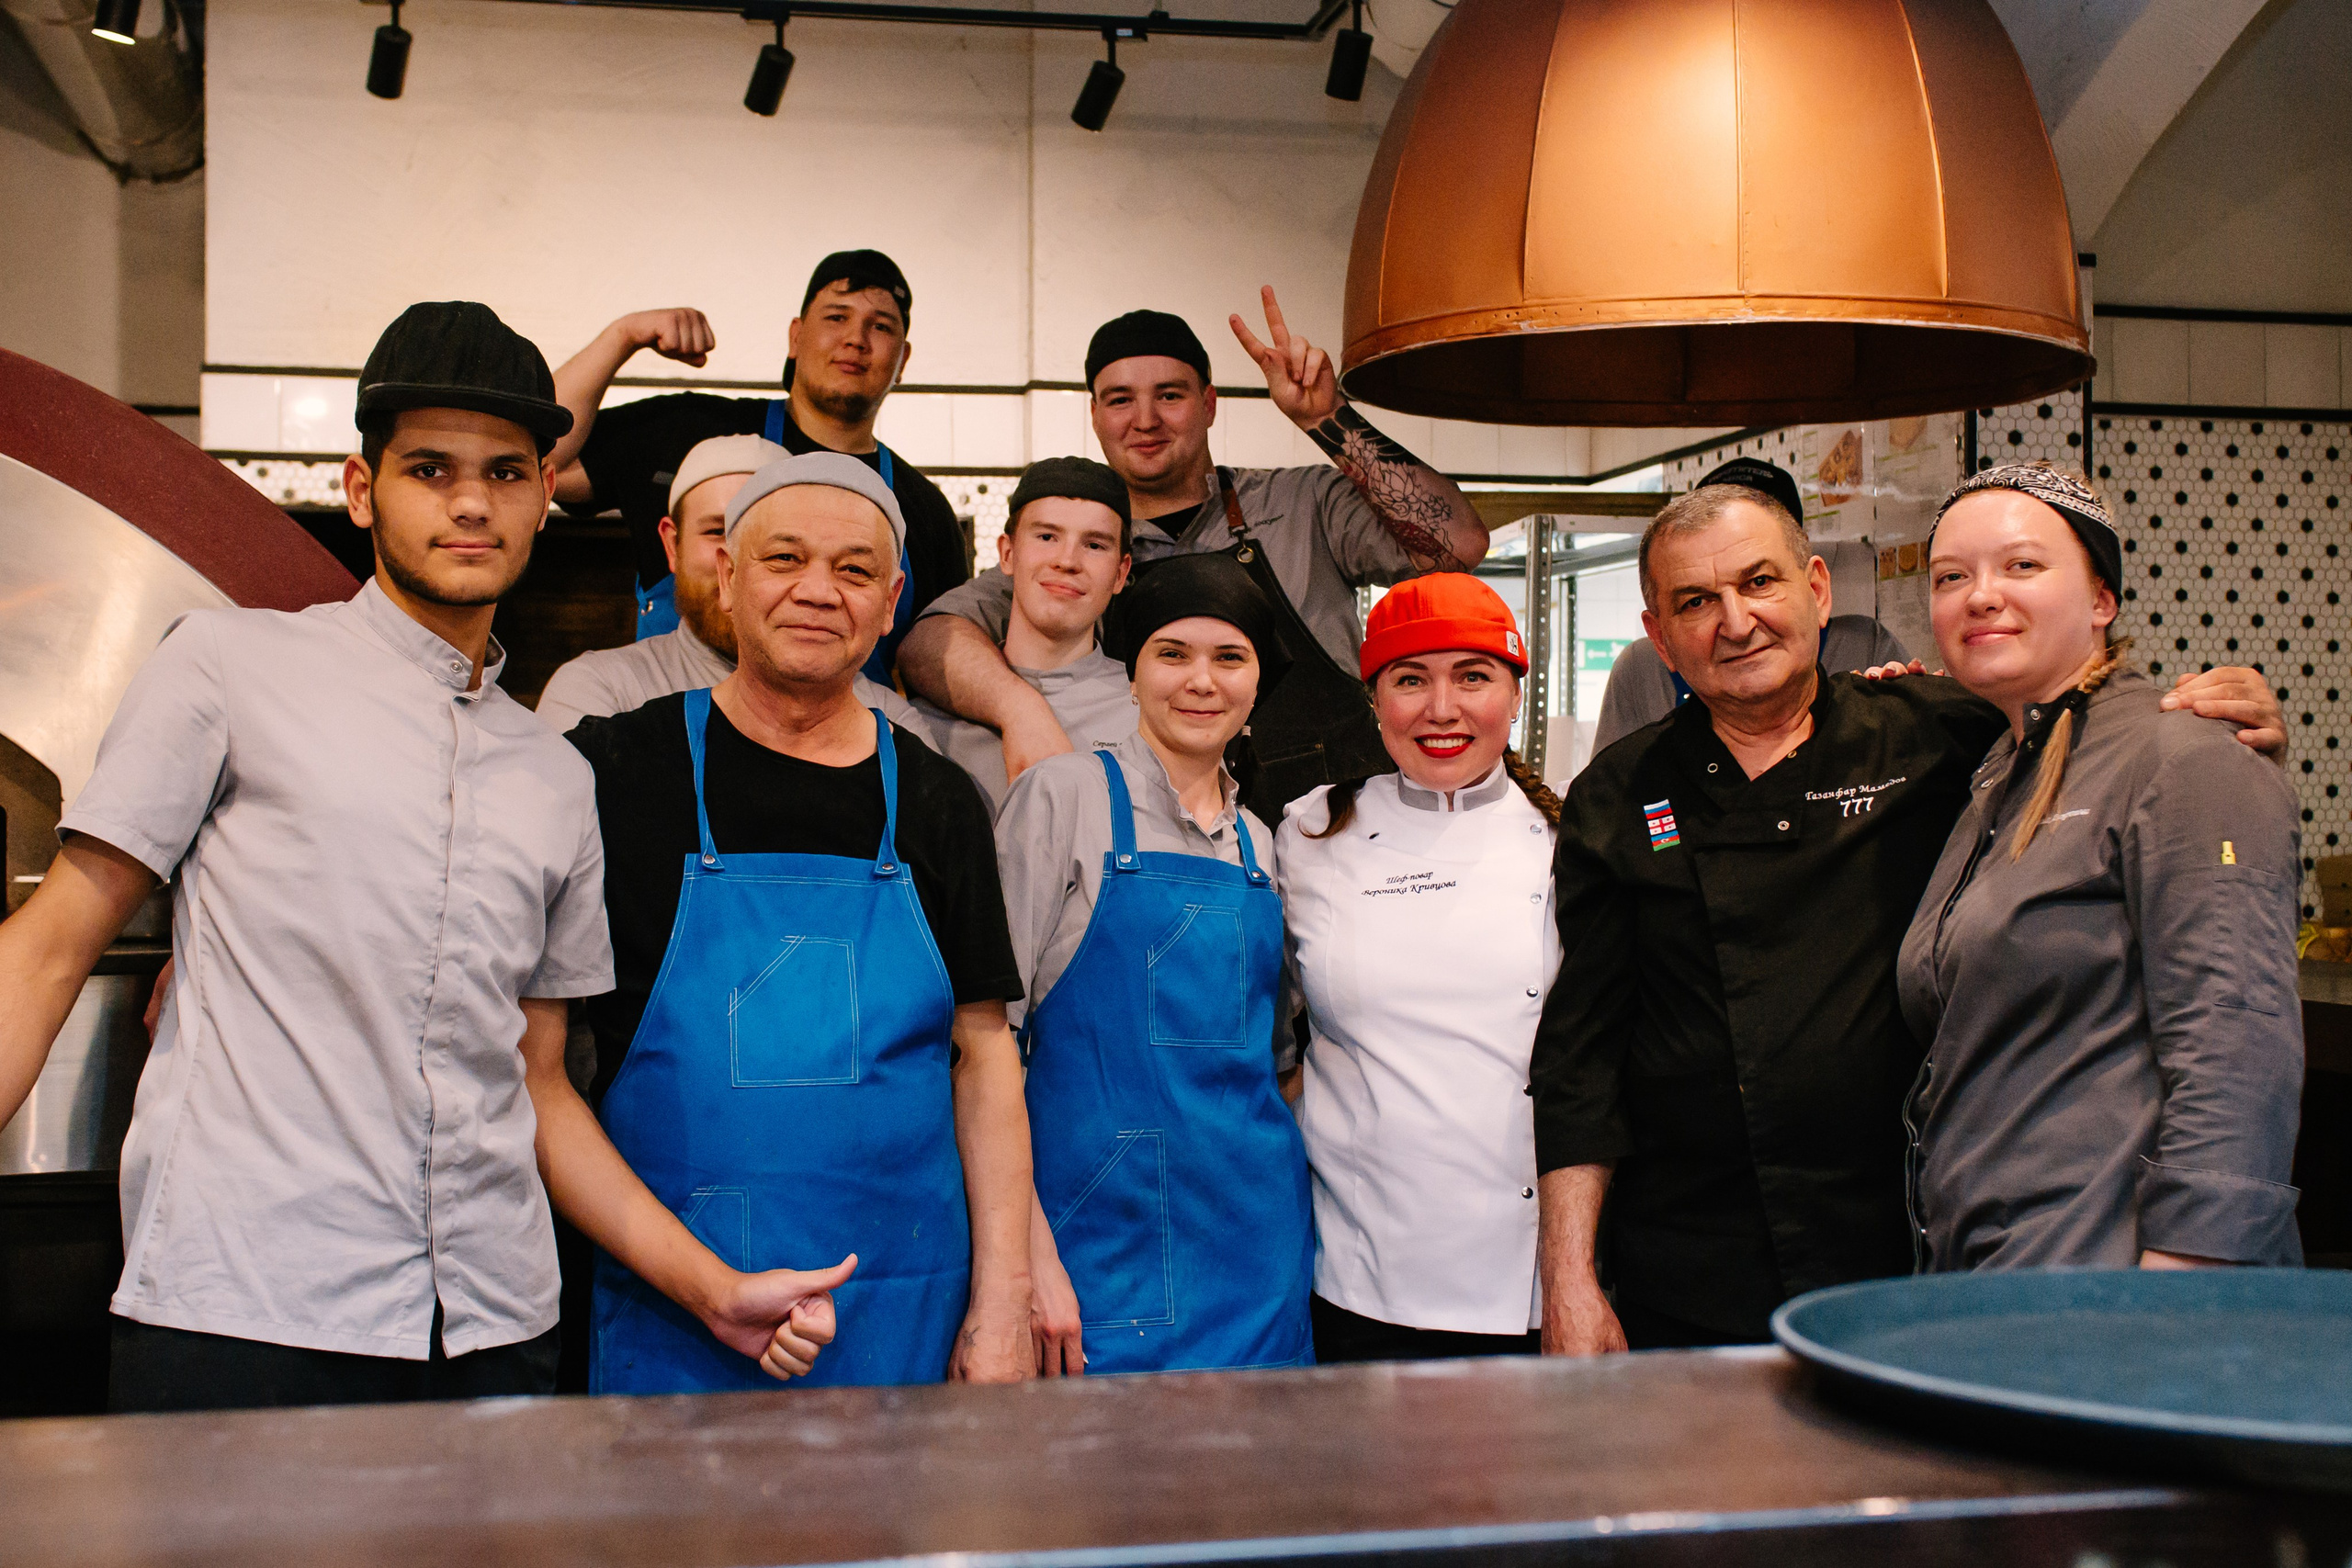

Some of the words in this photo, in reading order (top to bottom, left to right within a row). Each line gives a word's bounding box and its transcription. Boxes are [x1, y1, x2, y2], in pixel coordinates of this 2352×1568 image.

[1804, 787, 1857, 801] Газанфар
[1859, 776, 1907, 793] Мамедов
[1839, 796, 1874, 818] 777
[1385, 871, 1434, 885] Шеф-повар
[1361, 886, 1408, 897] Вероника
[1409, 880, 1457, 894] Кривцова
